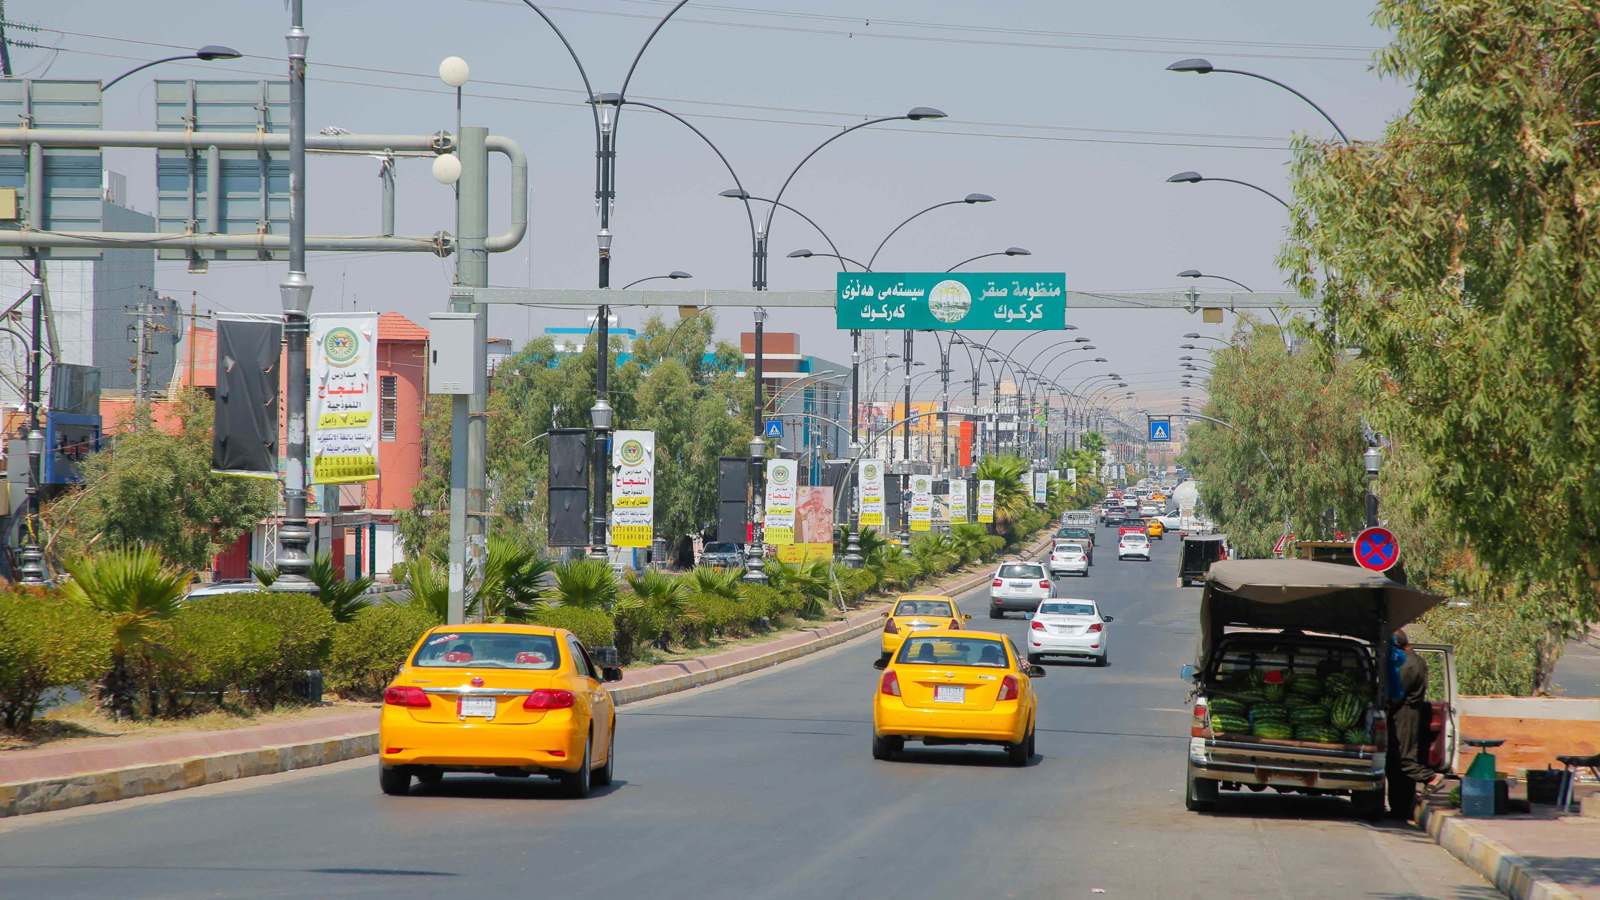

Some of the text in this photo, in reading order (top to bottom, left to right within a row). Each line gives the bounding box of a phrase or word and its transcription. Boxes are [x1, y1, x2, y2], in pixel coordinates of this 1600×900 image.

[978, 281, 1061, 301] منظومة صقر
[994, 304, 1043, 323] كركوك
[331, 371, 356, 380] مدارس
[318, 383, 368, 399] النجاح
[616, 477, 649, 488] النجاح
